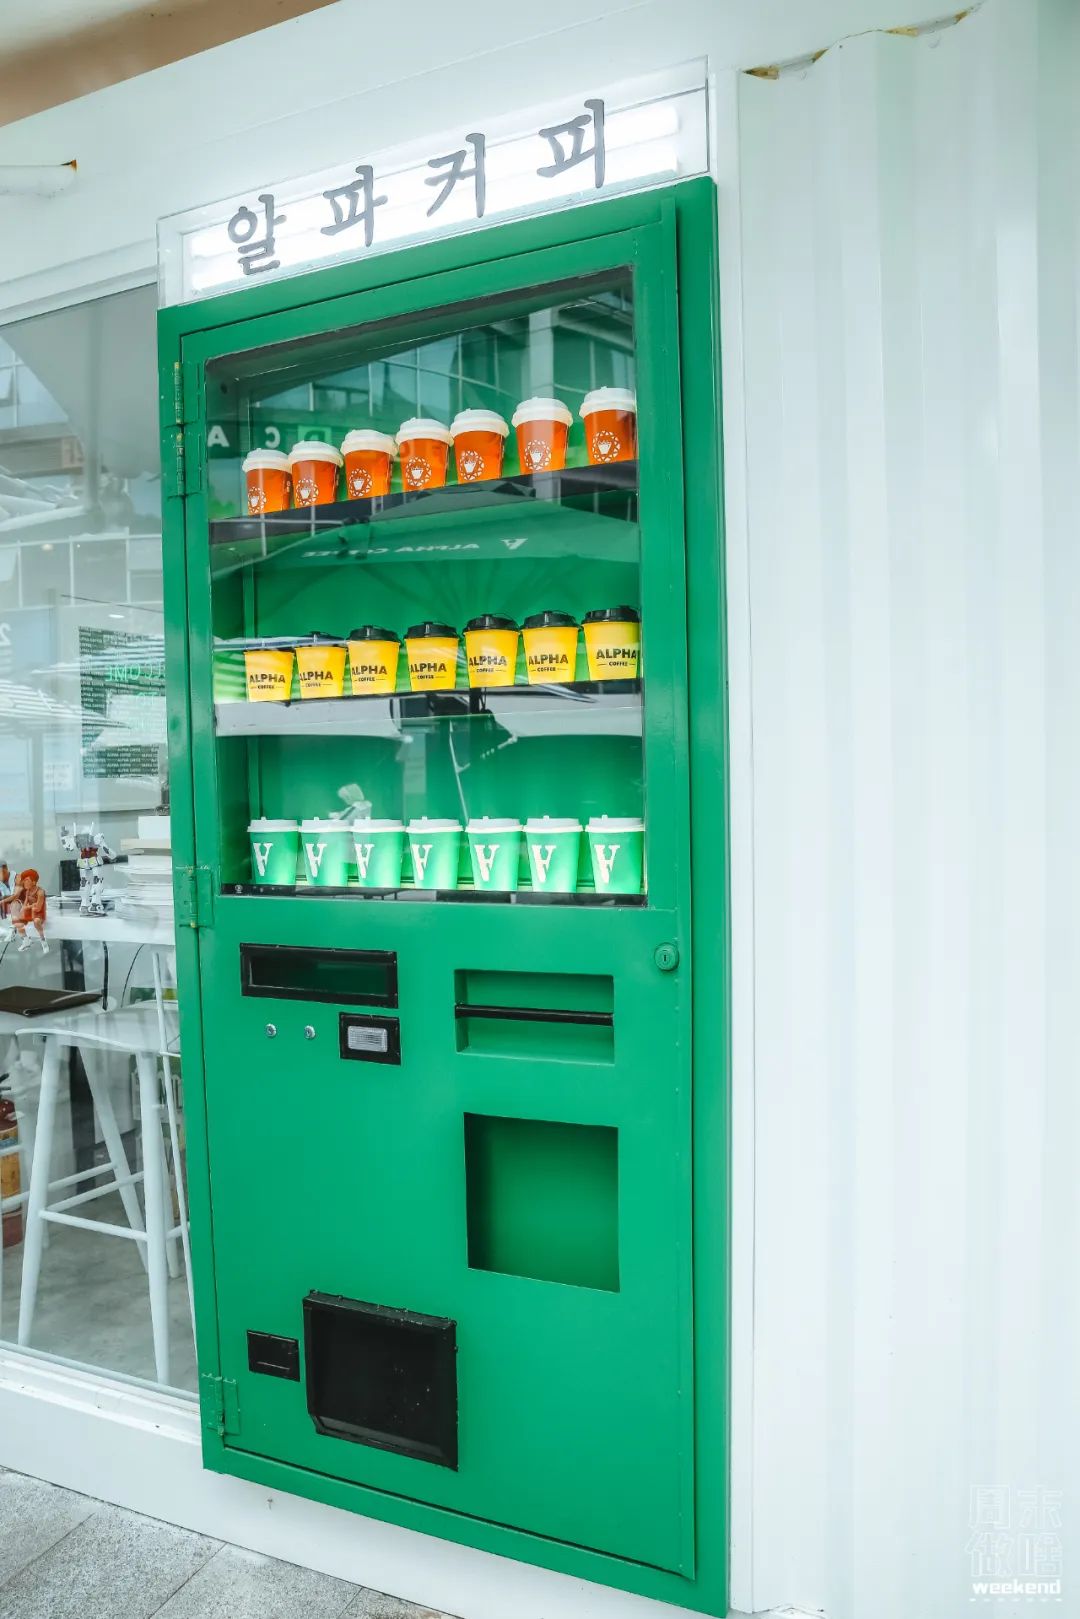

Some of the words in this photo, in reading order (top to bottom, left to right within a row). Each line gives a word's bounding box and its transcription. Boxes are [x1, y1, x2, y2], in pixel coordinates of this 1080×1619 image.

[227, 98, 606, 275] 알파커피
[596, 648, 637, 660] ALPHA
[469, 655, 507, 666] ALPHA
[528, 654, 569, 666] ALPHA
[351, 665, 388, 676] ALPHA
[410, 662, 447, 673] ALPHA
[250, 673, 286, 684] ALPHA
[299, 671, 334, 681] ALPHA
